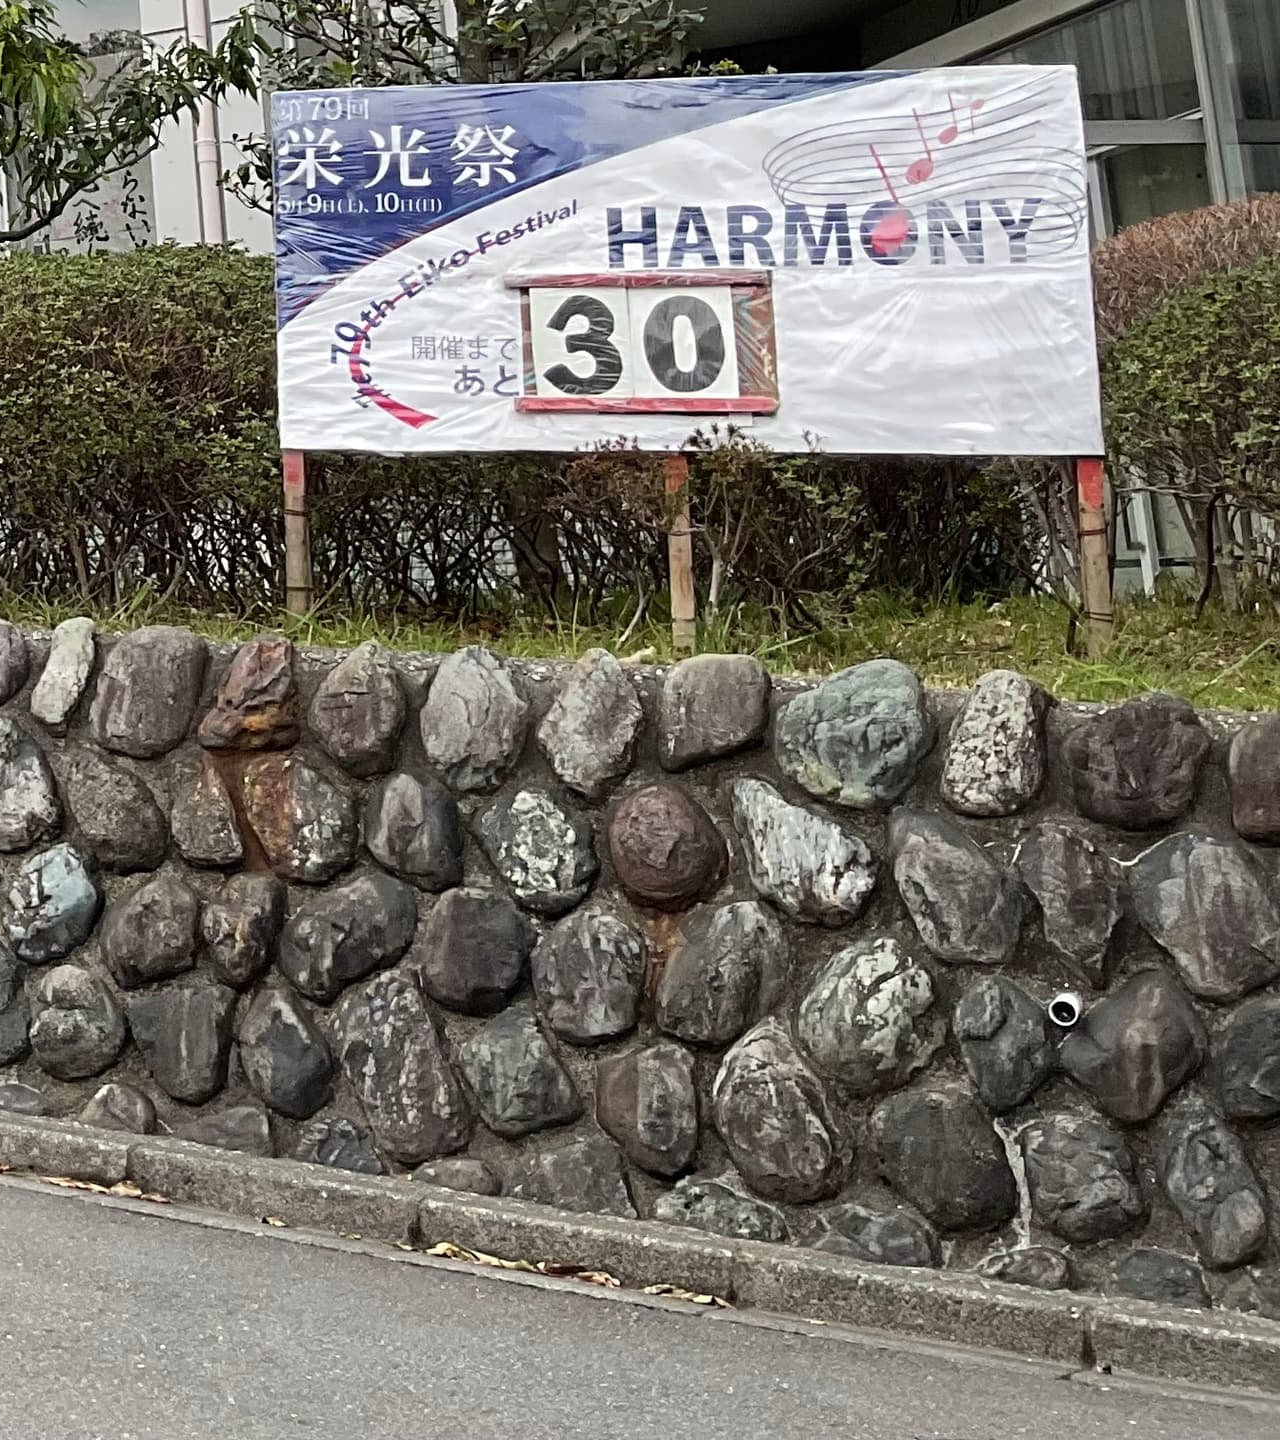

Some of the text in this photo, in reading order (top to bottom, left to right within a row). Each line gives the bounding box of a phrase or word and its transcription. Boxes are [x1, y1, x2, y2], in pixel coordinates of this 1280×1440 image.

[278, 124, 520, 189] 栄光祭
[606, 197, 1042, 267] HARMONY
[330, 298, 395, 367] 79th
[398, 249, 470, 299] Eiko
[475, 199, 578, 255] Festival
[411, 336, 519, 361] 開催まで
[544, 294, 728, 396] 30
[454, 364, 520, 397] あと
